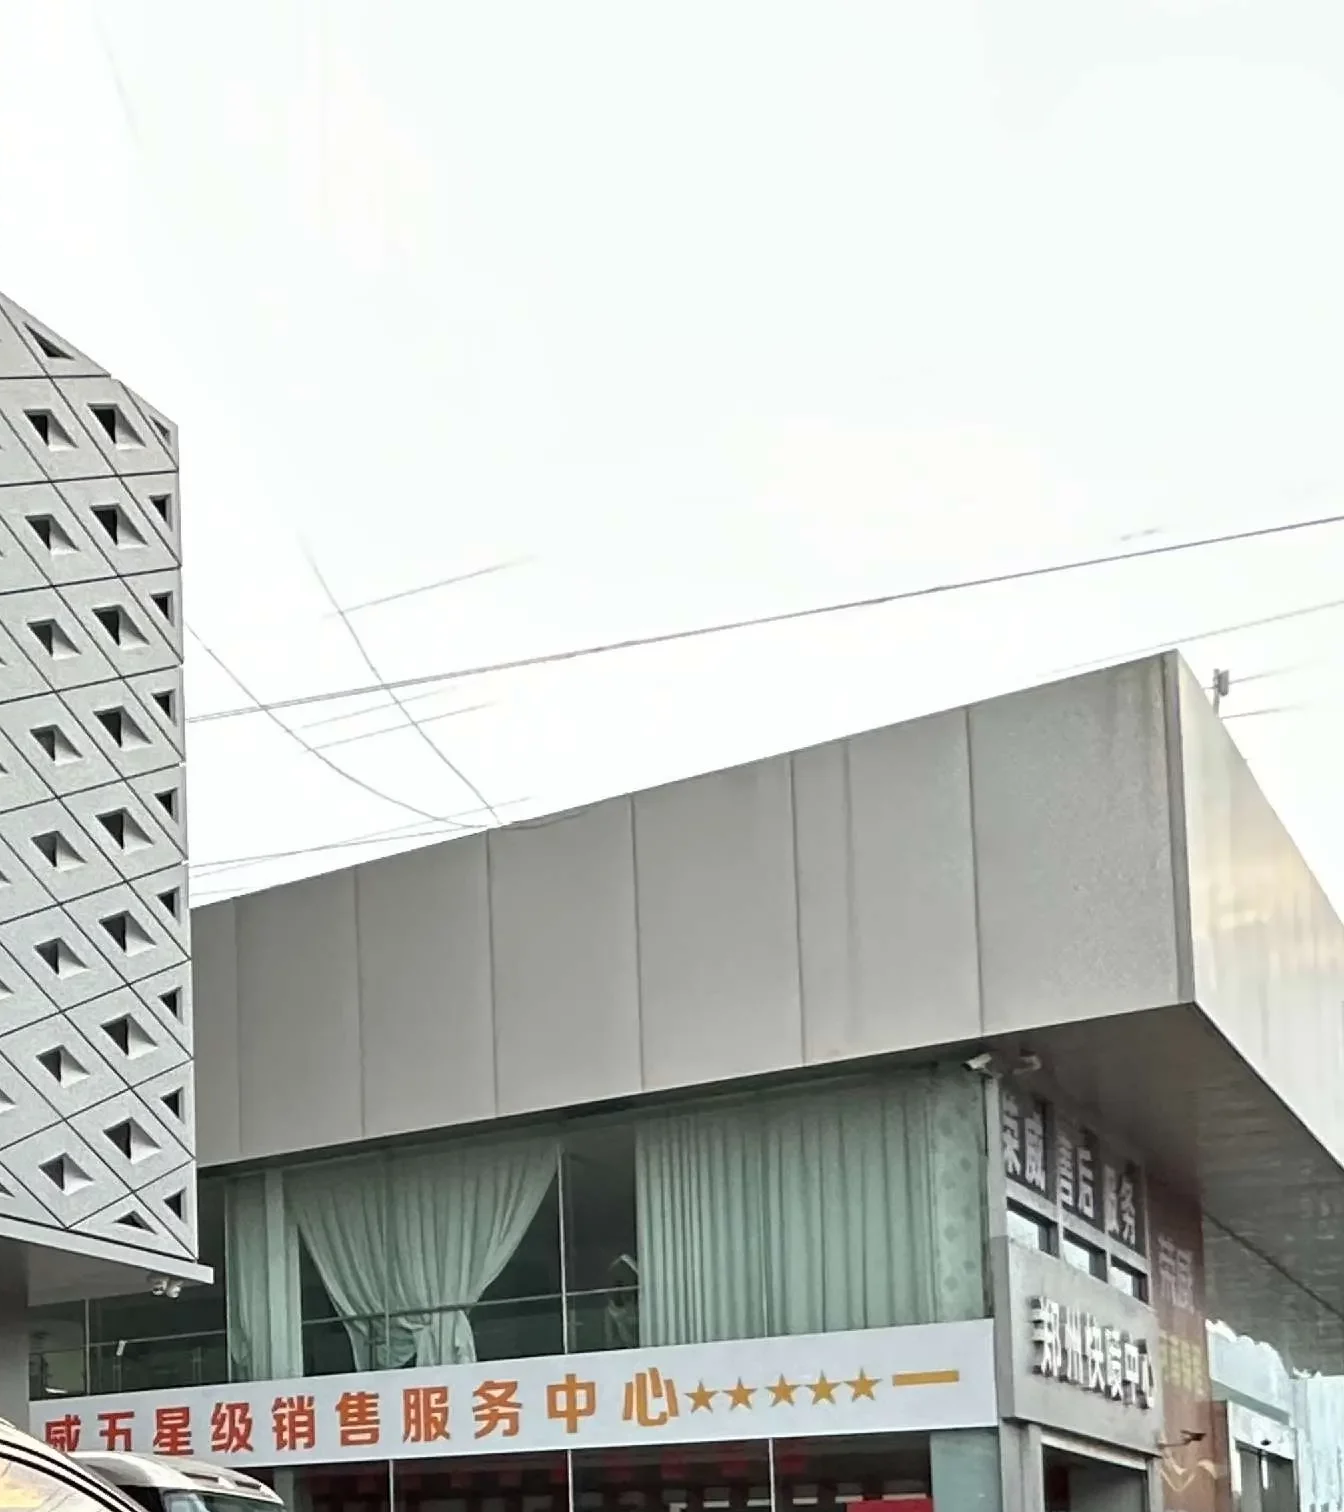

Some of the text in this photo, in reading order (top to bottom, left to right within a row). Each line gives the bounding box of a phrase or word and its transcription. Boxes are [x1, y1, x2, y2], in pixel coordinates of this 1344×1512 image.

[44, 1366, 679, 1456] 威五星级销售服务中心
